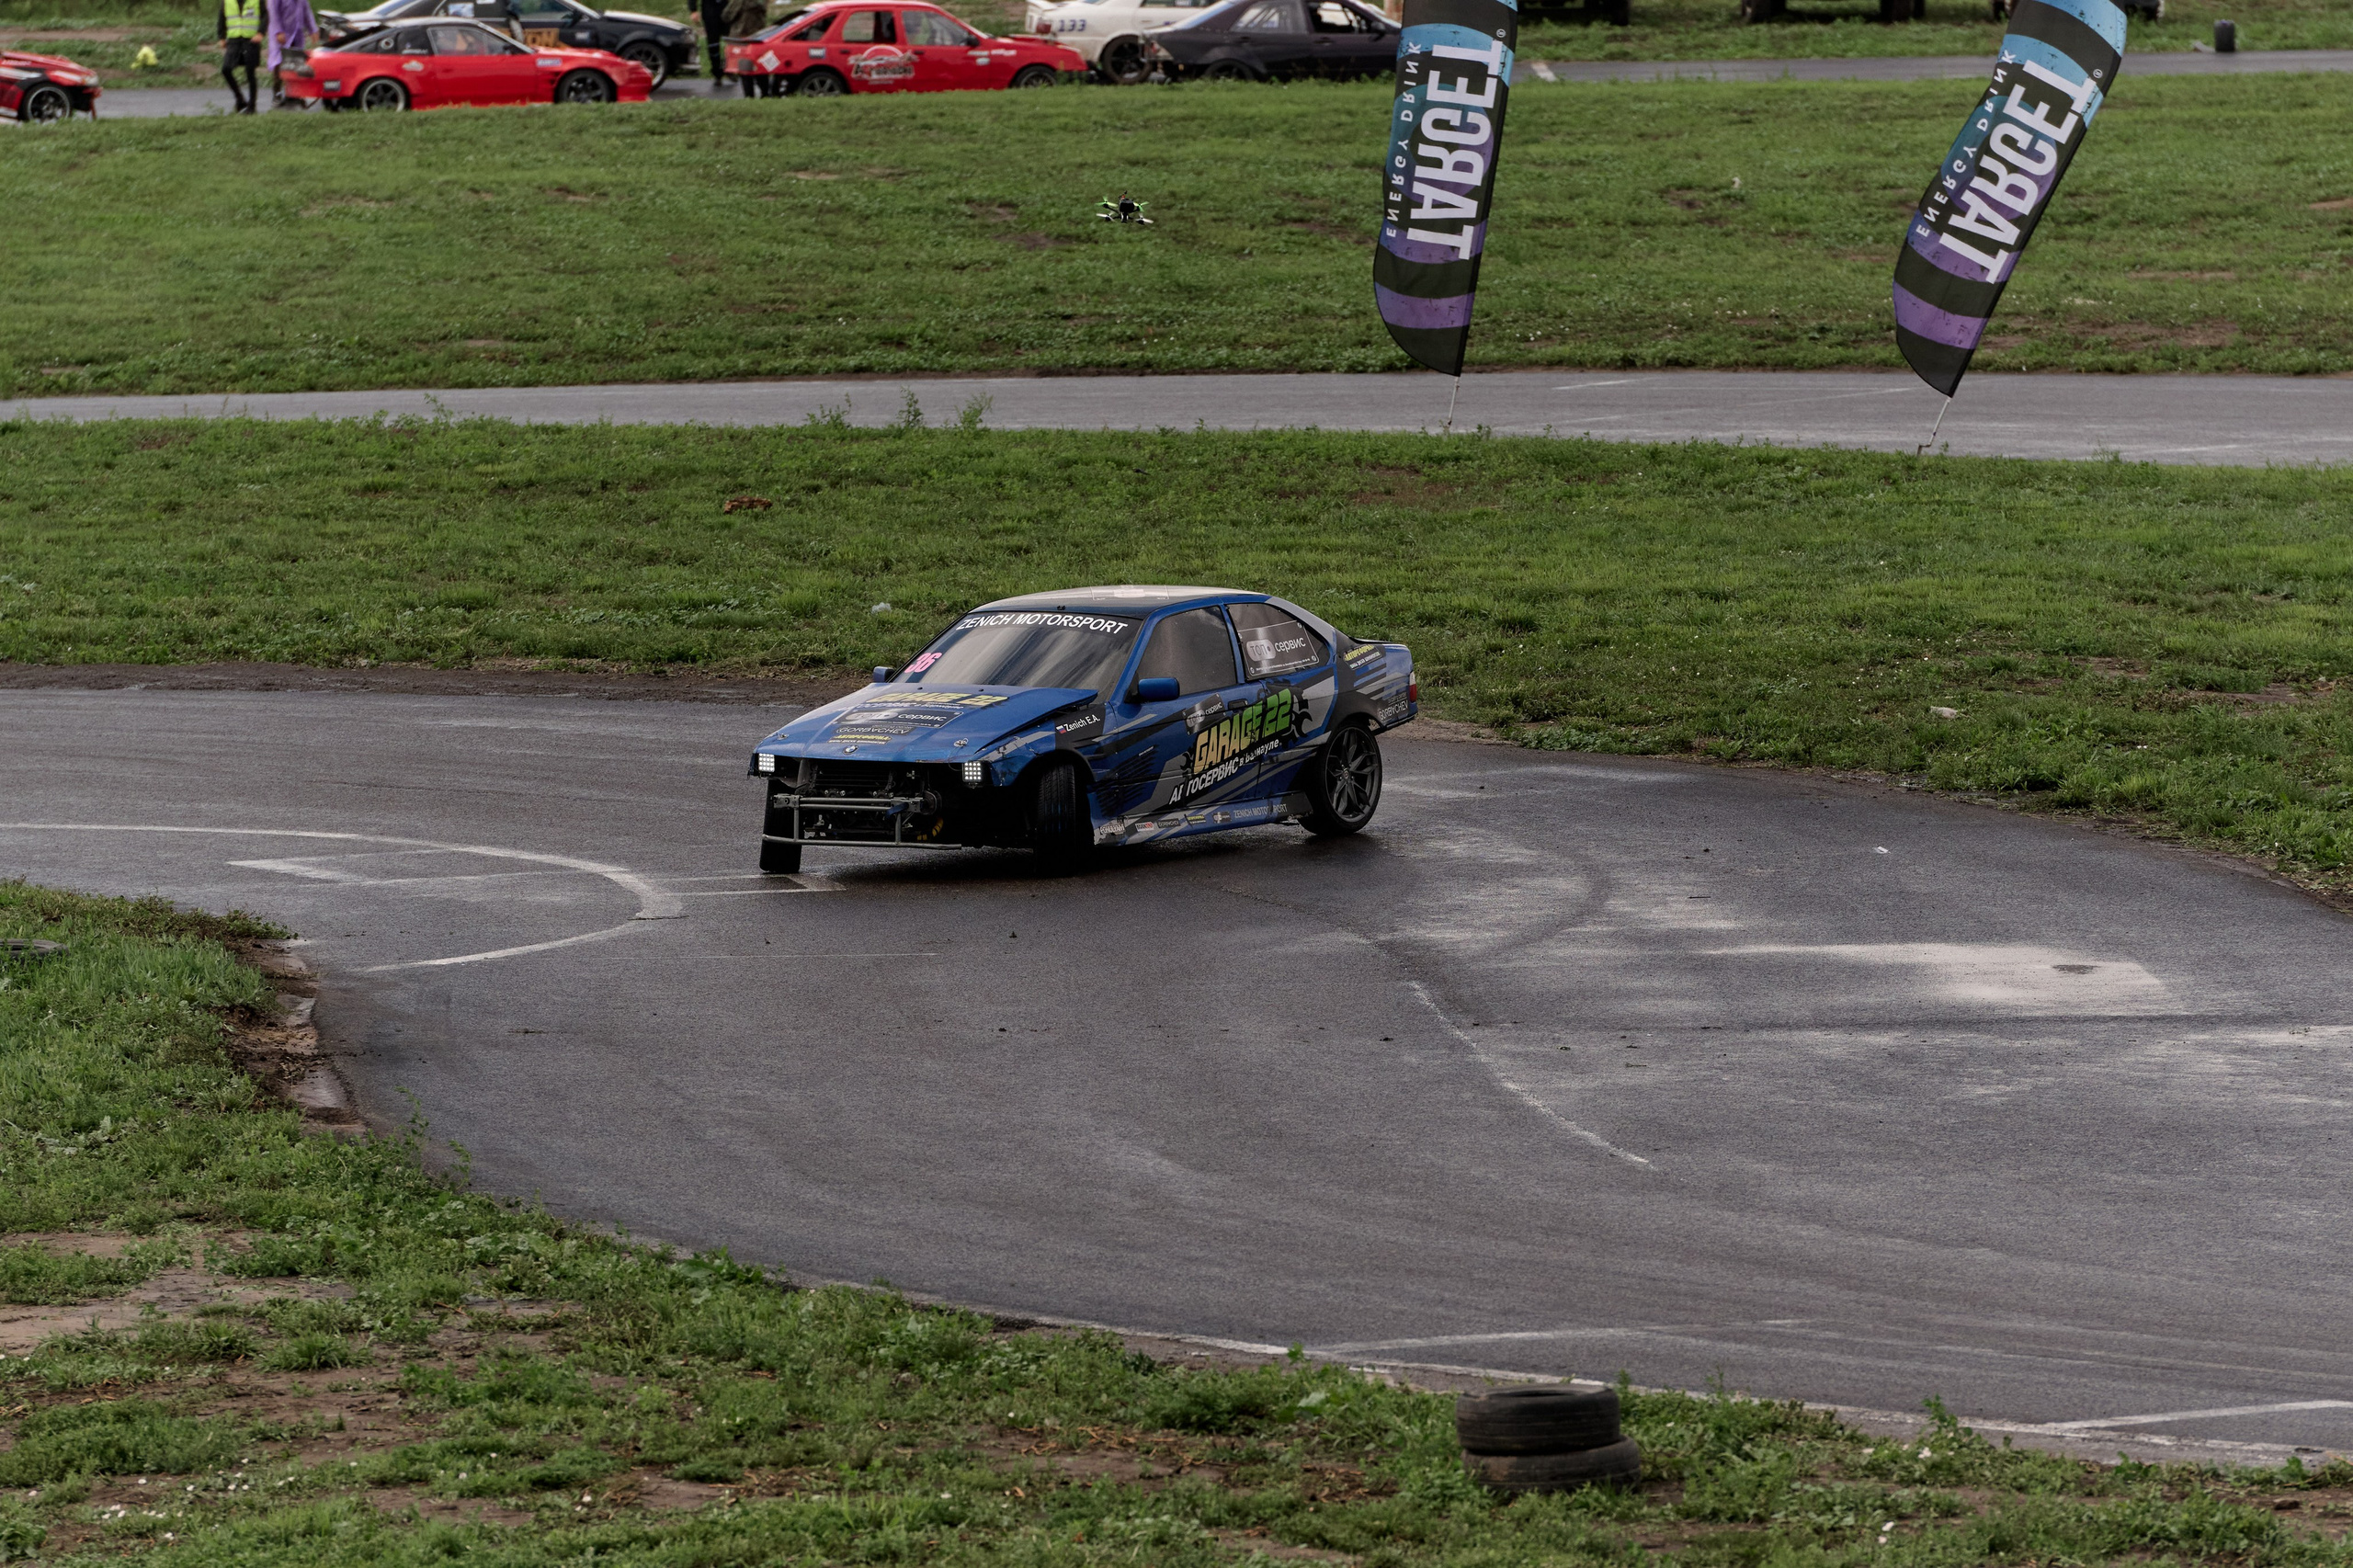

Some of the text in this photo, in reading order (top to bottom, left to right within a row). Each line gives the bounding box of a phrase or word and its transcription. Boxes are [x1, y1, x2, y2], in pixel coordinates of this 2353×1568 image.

[1058, 19, 1086, 32] 133
[956, 614, 1128, 634] ZENICH MOTORSPORT
[1275, 637, 1306, 653] сервис
[904, 652, 942, 674] 36
[1205, 702, 1222, 715] сервис
[897, 712, 948, 722] сервис
[1063, 714, 1101, 732] Zenich E.A.
[1194, 688, 1292, 774] GARAGE 22
[1233, 808, 1253, 819] ZENICH
[1253, 803, 1288, 816] MOTOPORT
